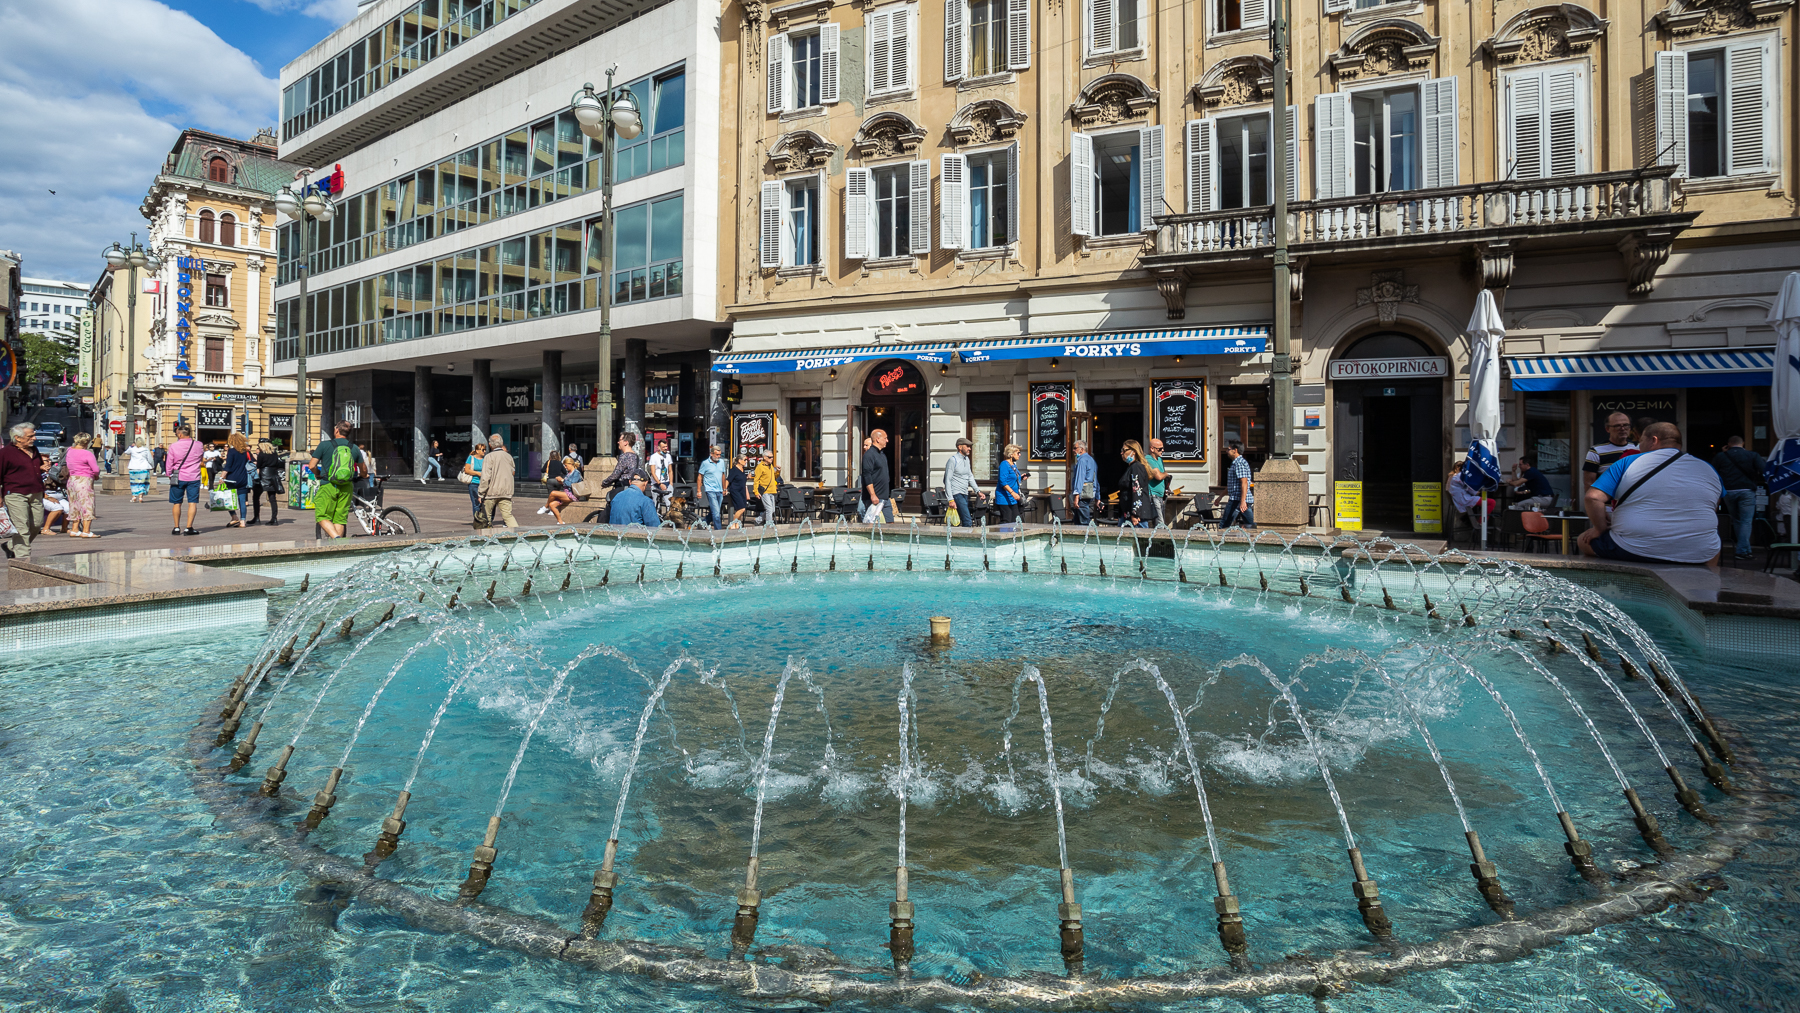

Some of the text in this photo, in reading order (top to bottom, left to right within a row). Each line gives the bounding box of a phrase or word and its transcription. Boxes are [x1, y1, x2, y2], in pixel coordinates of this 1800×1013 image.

[177, 256, 206, 271] HOTEL
[176, 272, 191, 370] BONAVIA
[1063, 343, 1141, 357] PORKY'S
[796, 357, 854, 371] PORKY'S
[916, 355, 943, 363] PORKY'S
[1338, 361, 1439, 375] FOTOKOPIRNICA
[506, 394, 529, 408] 0-24h
[1597, 401, 1673, 410] ACADEMIA
